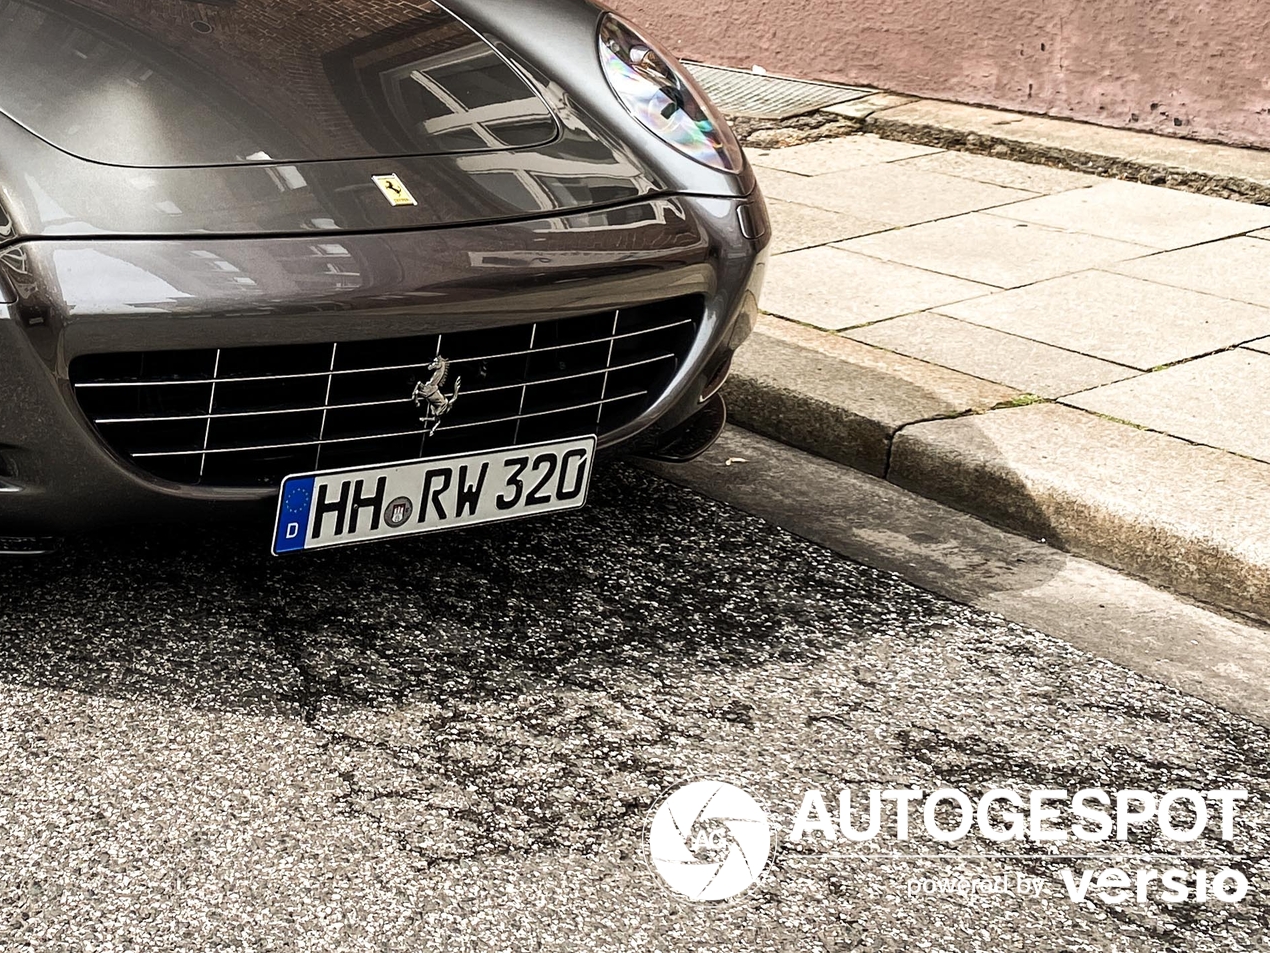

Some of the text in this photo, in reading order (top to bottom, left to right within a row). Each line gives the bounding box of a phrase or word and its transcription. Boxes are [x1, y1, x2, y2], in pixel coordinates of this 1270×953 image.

[285, 448, 588, 539] D HH RW 320
